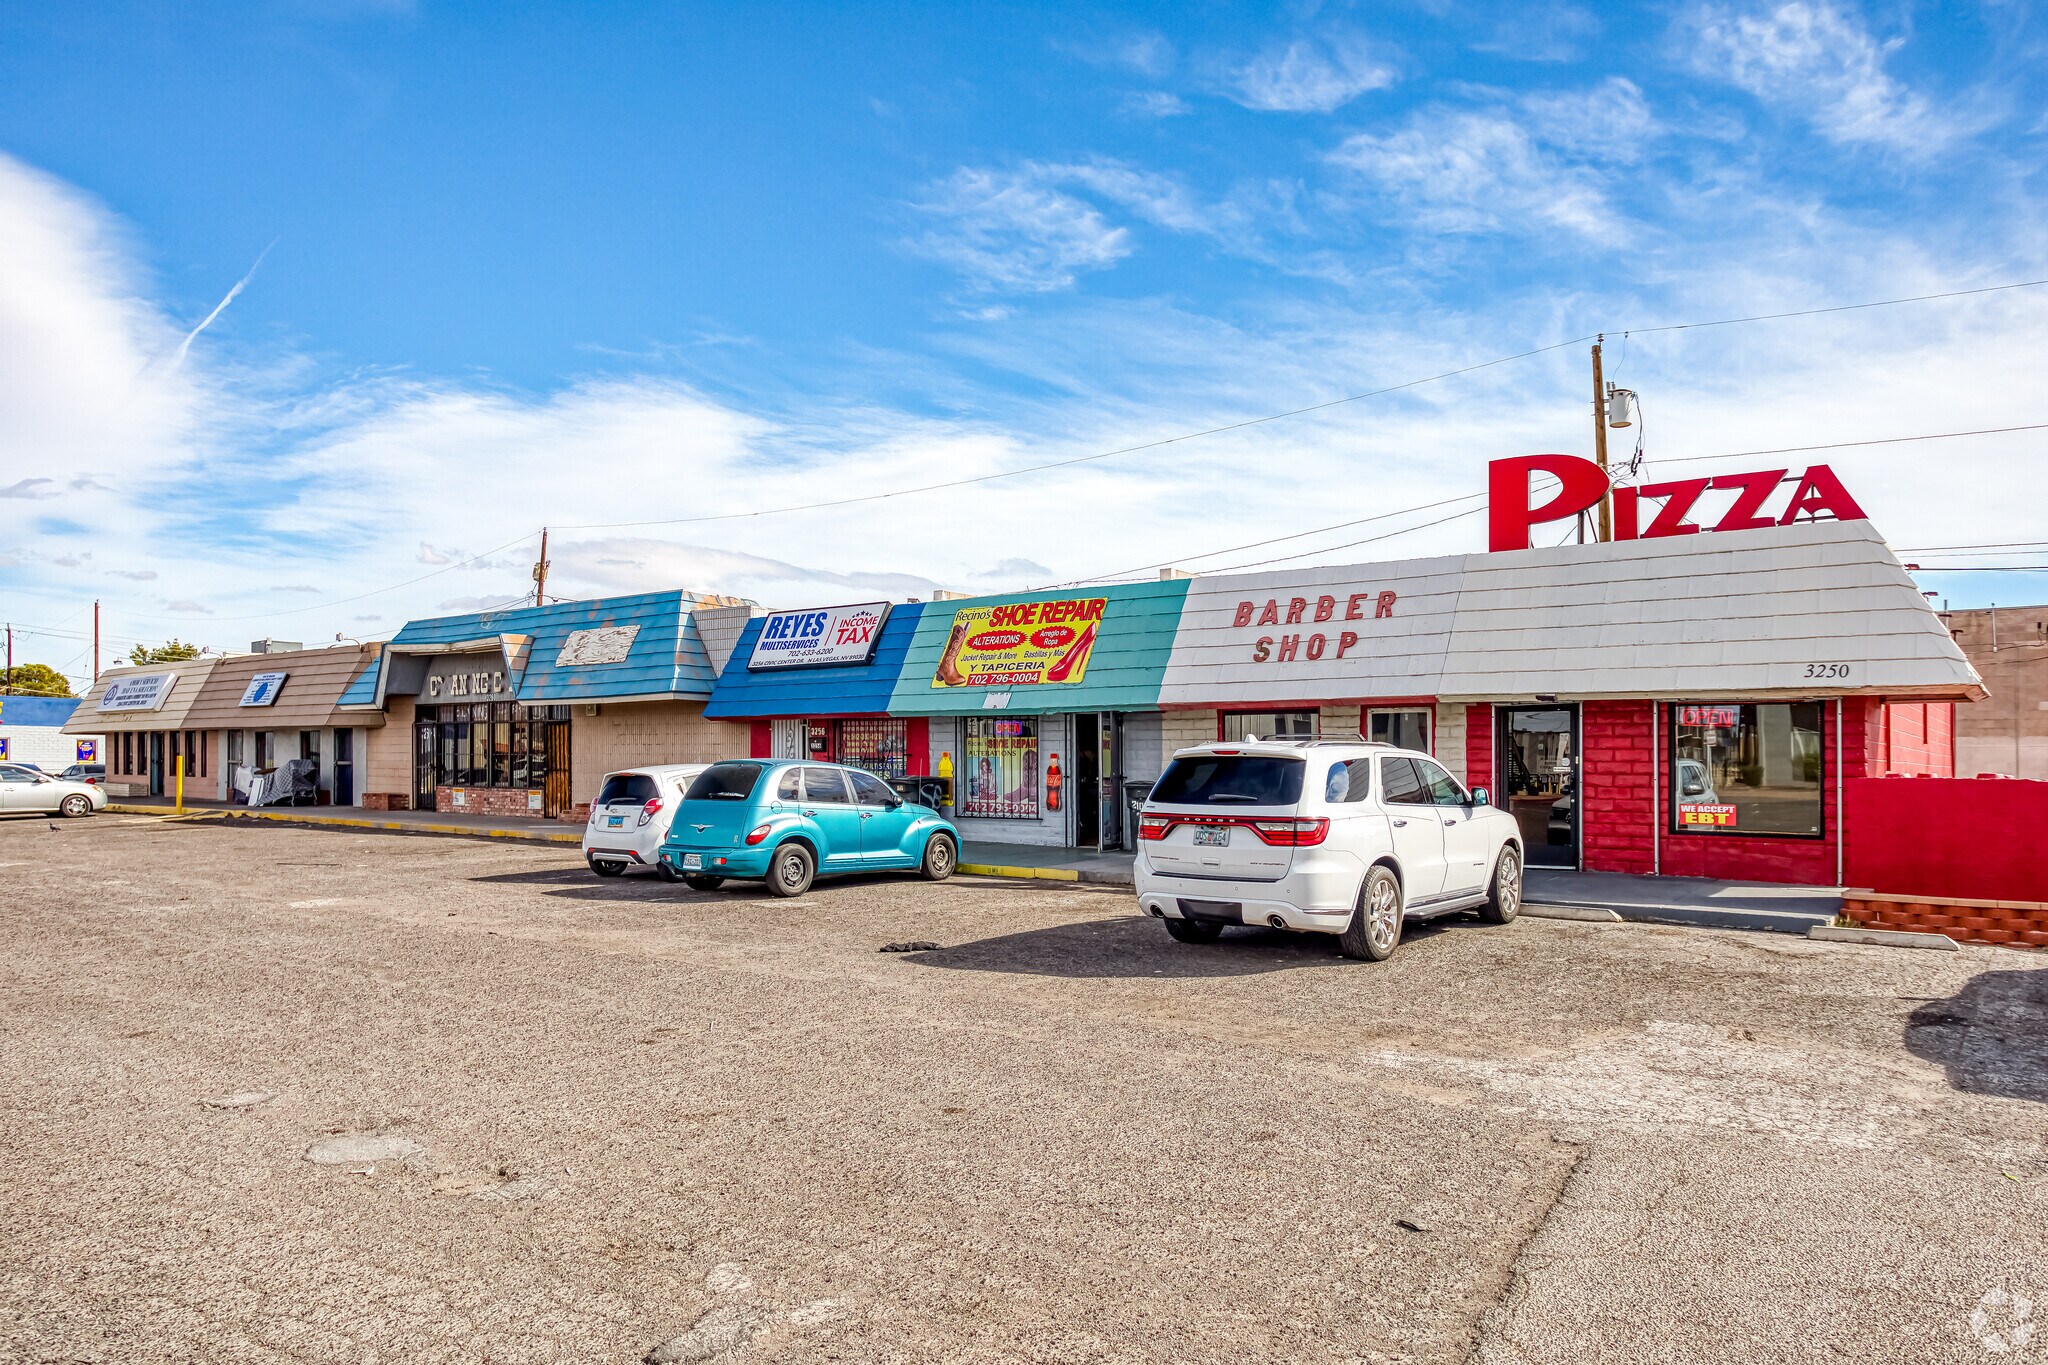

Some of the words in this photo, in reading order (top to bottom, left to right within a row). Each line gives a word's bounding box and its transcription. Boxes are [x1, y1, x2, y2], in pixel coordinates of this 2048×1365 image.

[1489, 453, 1869, 553] PIZZA
[955, 610, 992, 622] Recino's
[989, 604, 1039, 628] SHOE
[1039, 599, 1105, 624] REPAIR
[1232, 591, 1397, 627] BARBER
[765, 613, 827, 639] REYES
[840, 616, 879, 627] INCOME
[836, 625, 875, 646] TAX
[971, 634, 1021, 646] ALTERATIONS
[760, 639, 820, 651] MULTISERVICES
[1043, 639, 1058, 647] Ropa
[1253, 632, 1358, 662] SHOP
[787, 648, 834, 657] 702-633-6200
[961, 653, 978, 662] Jacket
[978, 652, 997, 662] Repair
[1002, 652, 1018, 660] More
[1024, 649, 1047, 660] Bastillas
[970, 664, 978, 672] Y
[981, 661, 1046, 673] TAPICERIA
[1804, 664, 1849, 678] 3250
[969, 674, 987, 684] 702
[989, 672, 1039, 684] 796-0004
[1684, 709, 1731, 724] OPEN
[811, 727, 826, 736] 3256
[995, 722, 1021, 733] OPEN
[969, 803, 987, 812] 702
[1680, 805, 1696, 813] WE
[1697, 805, 1735, 814] ACCEPT
[1685, 812, 1730, 825] EBT
